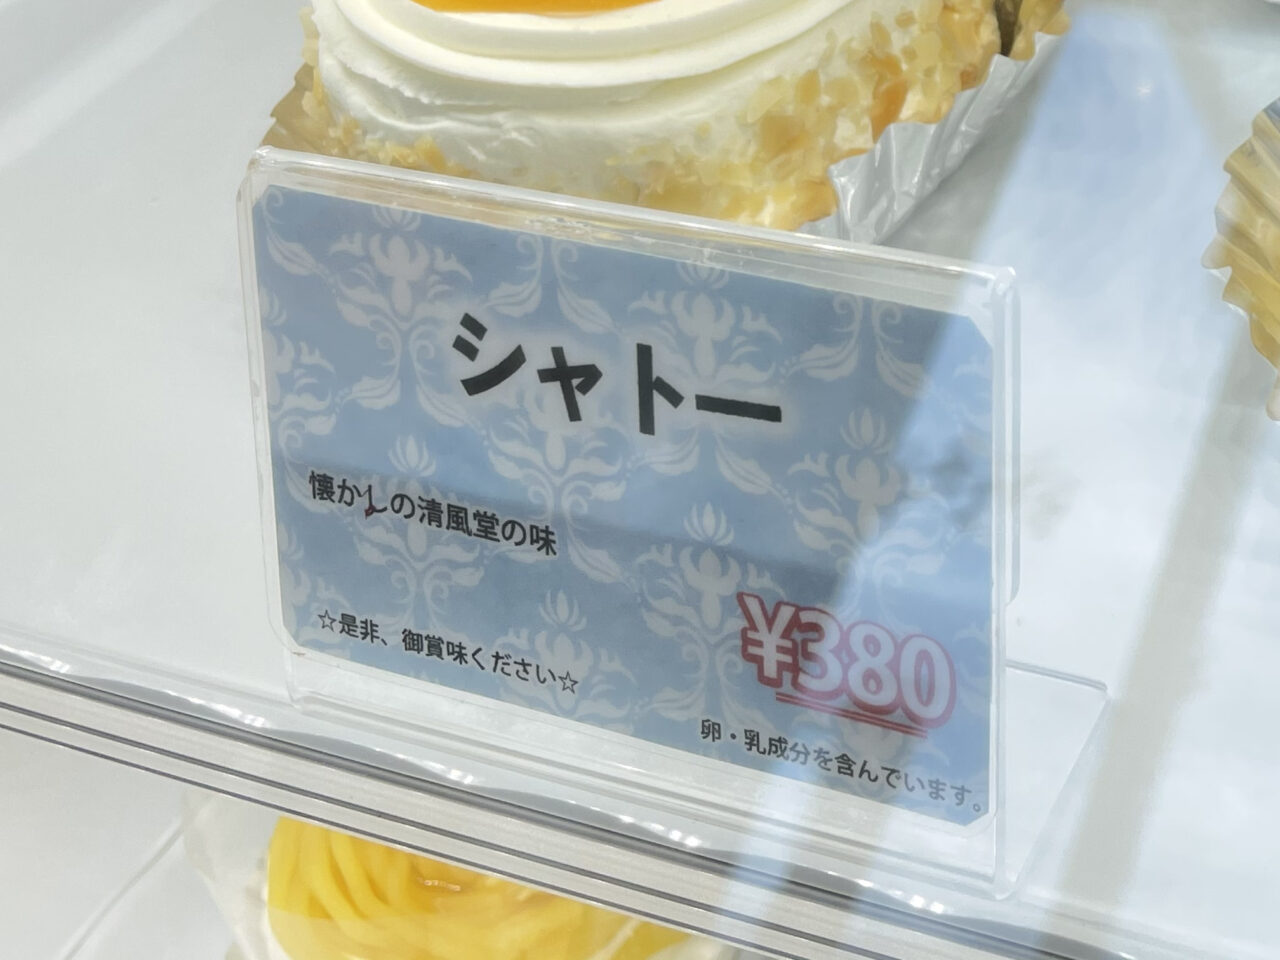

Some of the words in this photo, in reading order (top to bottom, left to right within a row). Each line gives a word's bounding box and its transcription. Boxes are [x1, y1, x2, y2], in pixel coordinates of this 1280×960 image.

[453, 312, 782, 436] シャトー
[309, 470, 557, 556] 懐かしの清風堂の味
[737, 592, 956, 729] ¥380
